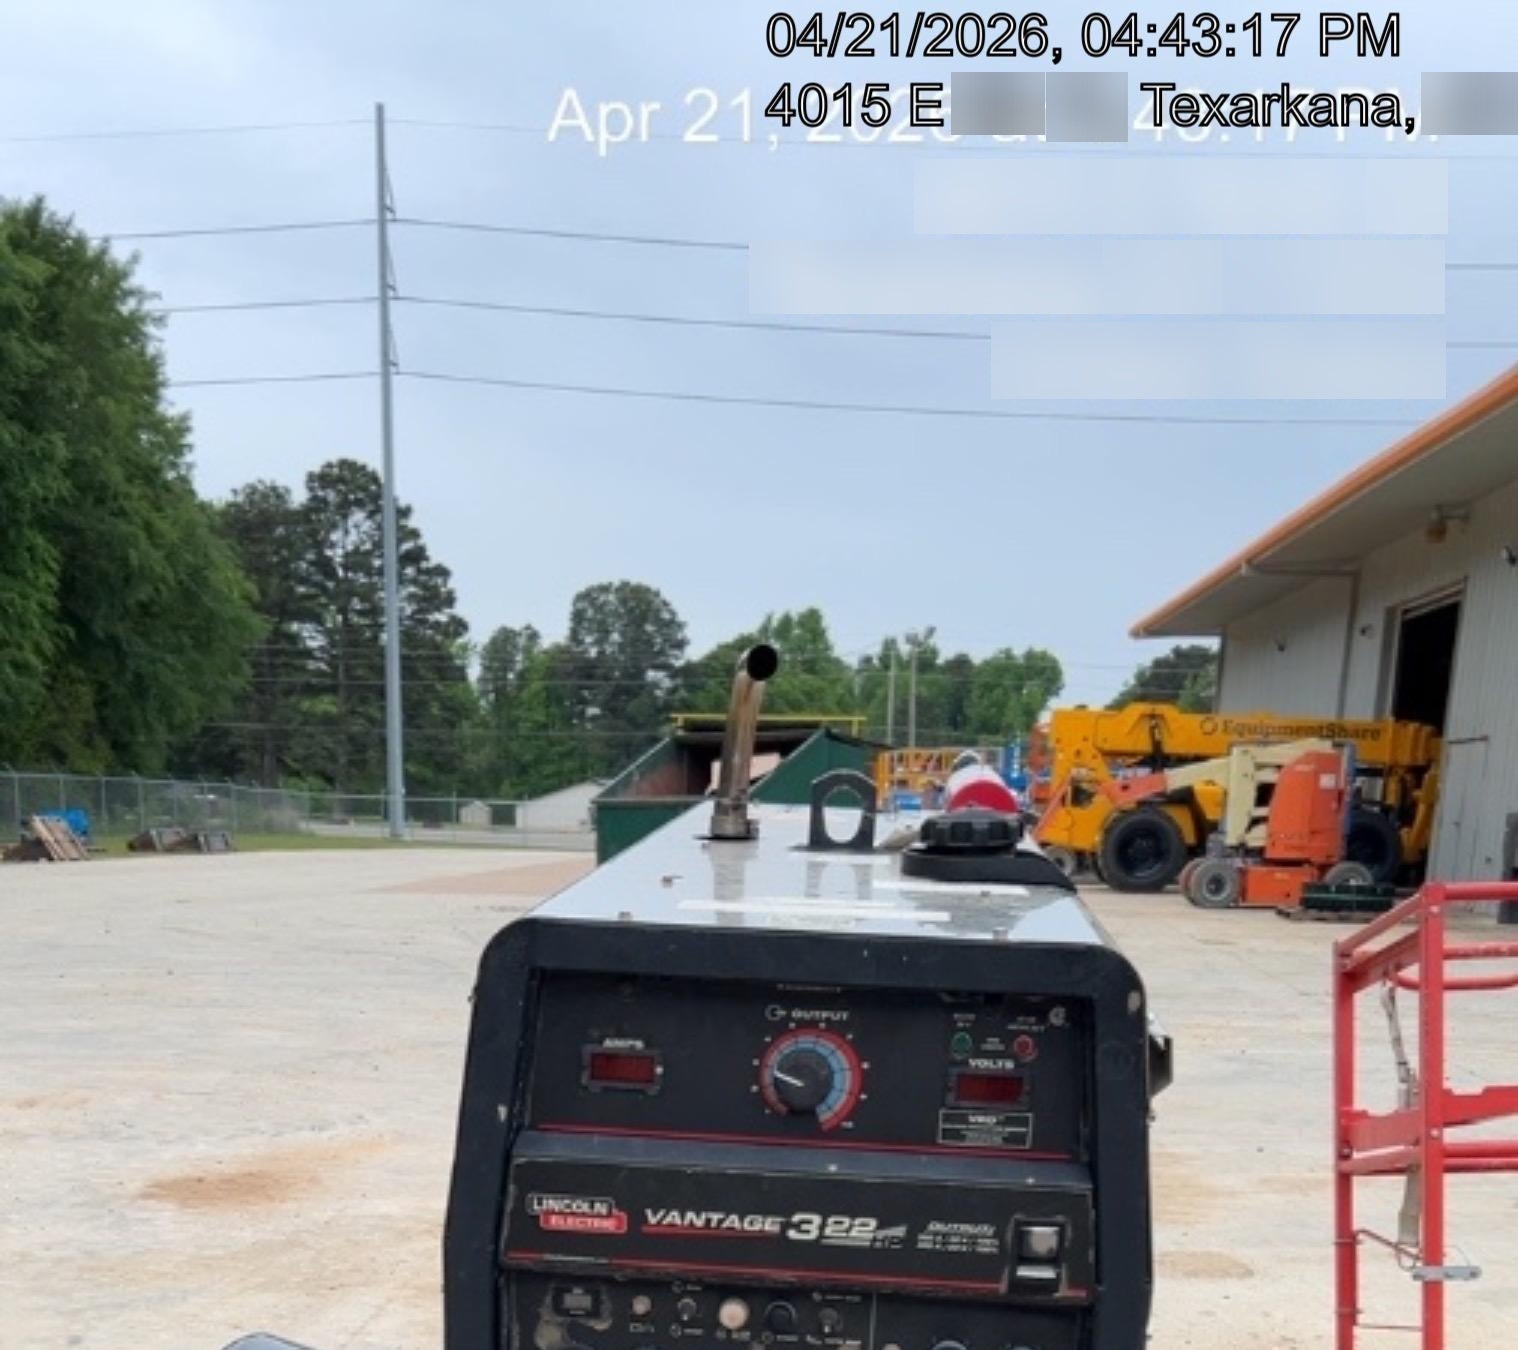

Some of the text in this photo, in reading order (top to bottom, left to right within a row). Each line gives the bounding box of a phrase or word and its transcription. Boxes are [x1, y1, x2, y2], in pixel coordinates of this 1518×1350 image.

[1221, 720, 1383, 741] EquipmentShare
[791, 1009, 850, 1021] OUTPUT
[968, 1058, 1015, 1070] VOLTS
[533, 1197, 609, 1217] LINCOLN
[549, 1214, 618, 1231] ELECTRIC
[643, 1208, 878, 1241] VANTAGE 322
